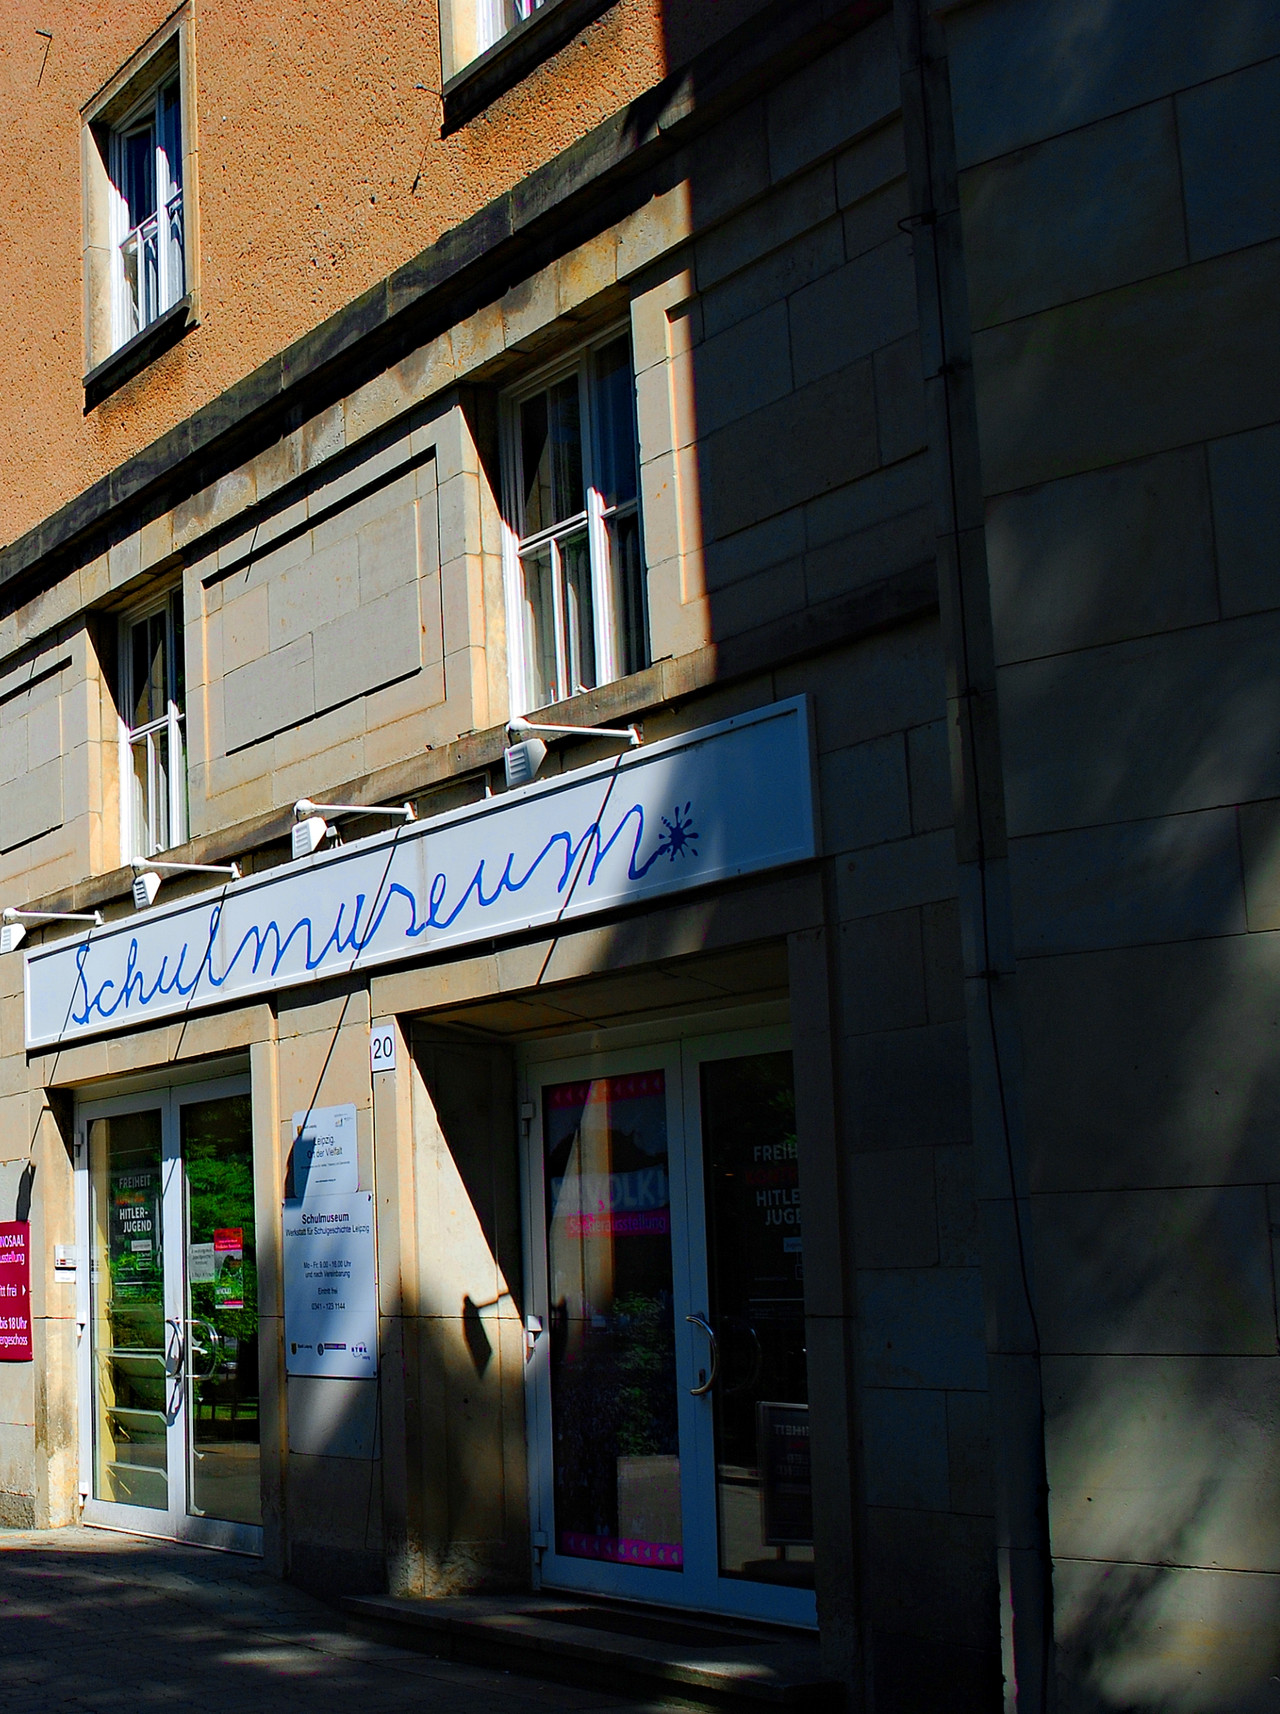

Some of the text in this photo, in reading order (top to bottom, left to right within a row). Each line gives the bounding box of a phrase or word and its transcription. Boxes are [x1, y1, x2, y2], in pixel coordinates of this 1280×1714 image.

[72, 803, 672, 1025] Schulmuseum
[373, 1036, 393, 1059] 20
[753, 1142, 798, 1162] FREIH
[119, 1174, 151, 1189] FREIHEIT
[756, 1188, 801, 1207] HITLE
[119, 1206, 149, 1220] HITLER-
[301, 1212, 350, 1225] Schulmuseum
[764, 1207, 802, 1226] JUGE
[122, 1219, 152, 1233] JUGEND
[314, 1225, 352, 1237] Schulgeschichte
[352, 1224, 370, 1234] Leipzig
[6, 1284, 18, 1297] frei
[0, 1316, 8, 1329] bis
[8, 1316, 16, 1329] 18
[16, 1316, 28, 1330] Uhr
